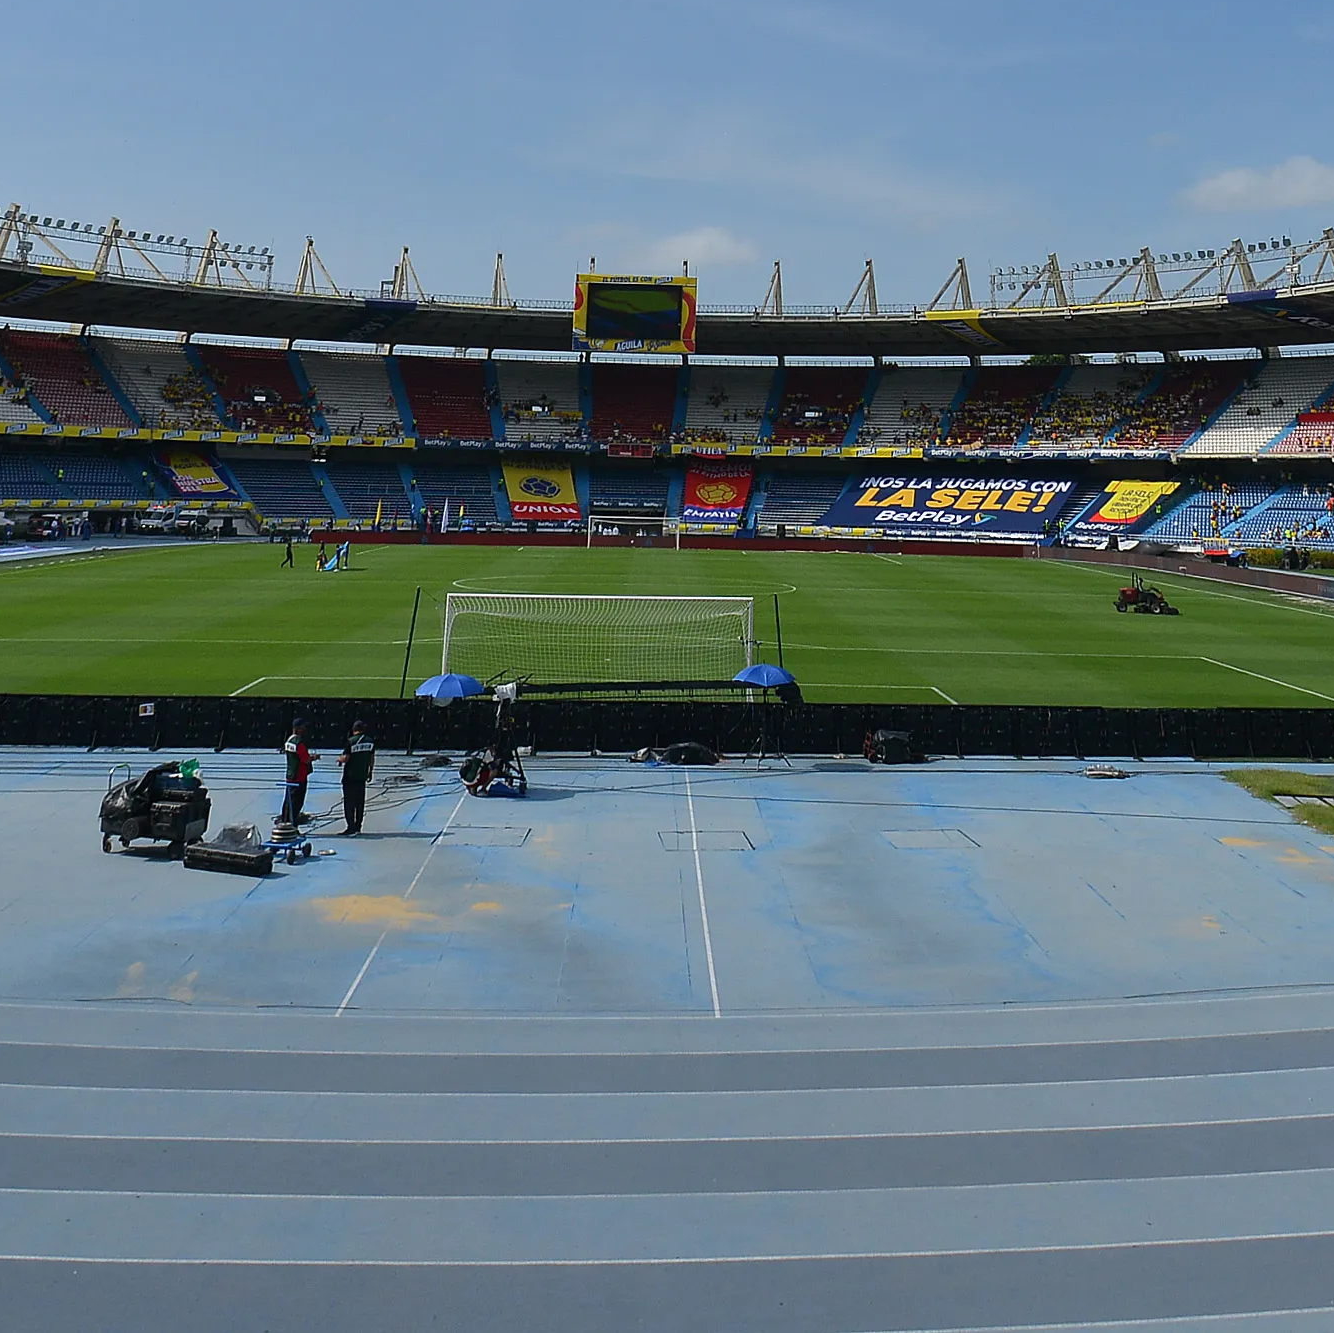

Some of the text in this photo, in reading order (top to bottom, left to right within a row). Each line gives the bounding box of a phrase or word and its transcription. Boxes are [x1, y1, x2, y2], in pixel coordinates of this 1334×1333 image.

[616, 340, 643, 351] AGUILA
[907, 477, 932, 489] LA
[934, 478, 1028, 492] JUGAMOS
[1029, 480, 1074, 493] CON
[854, 487, 1057, 513] LA SELE!
[874, 509, 972, 525] BetPlay
[1074, 521, 1119, 531] BetPlay
